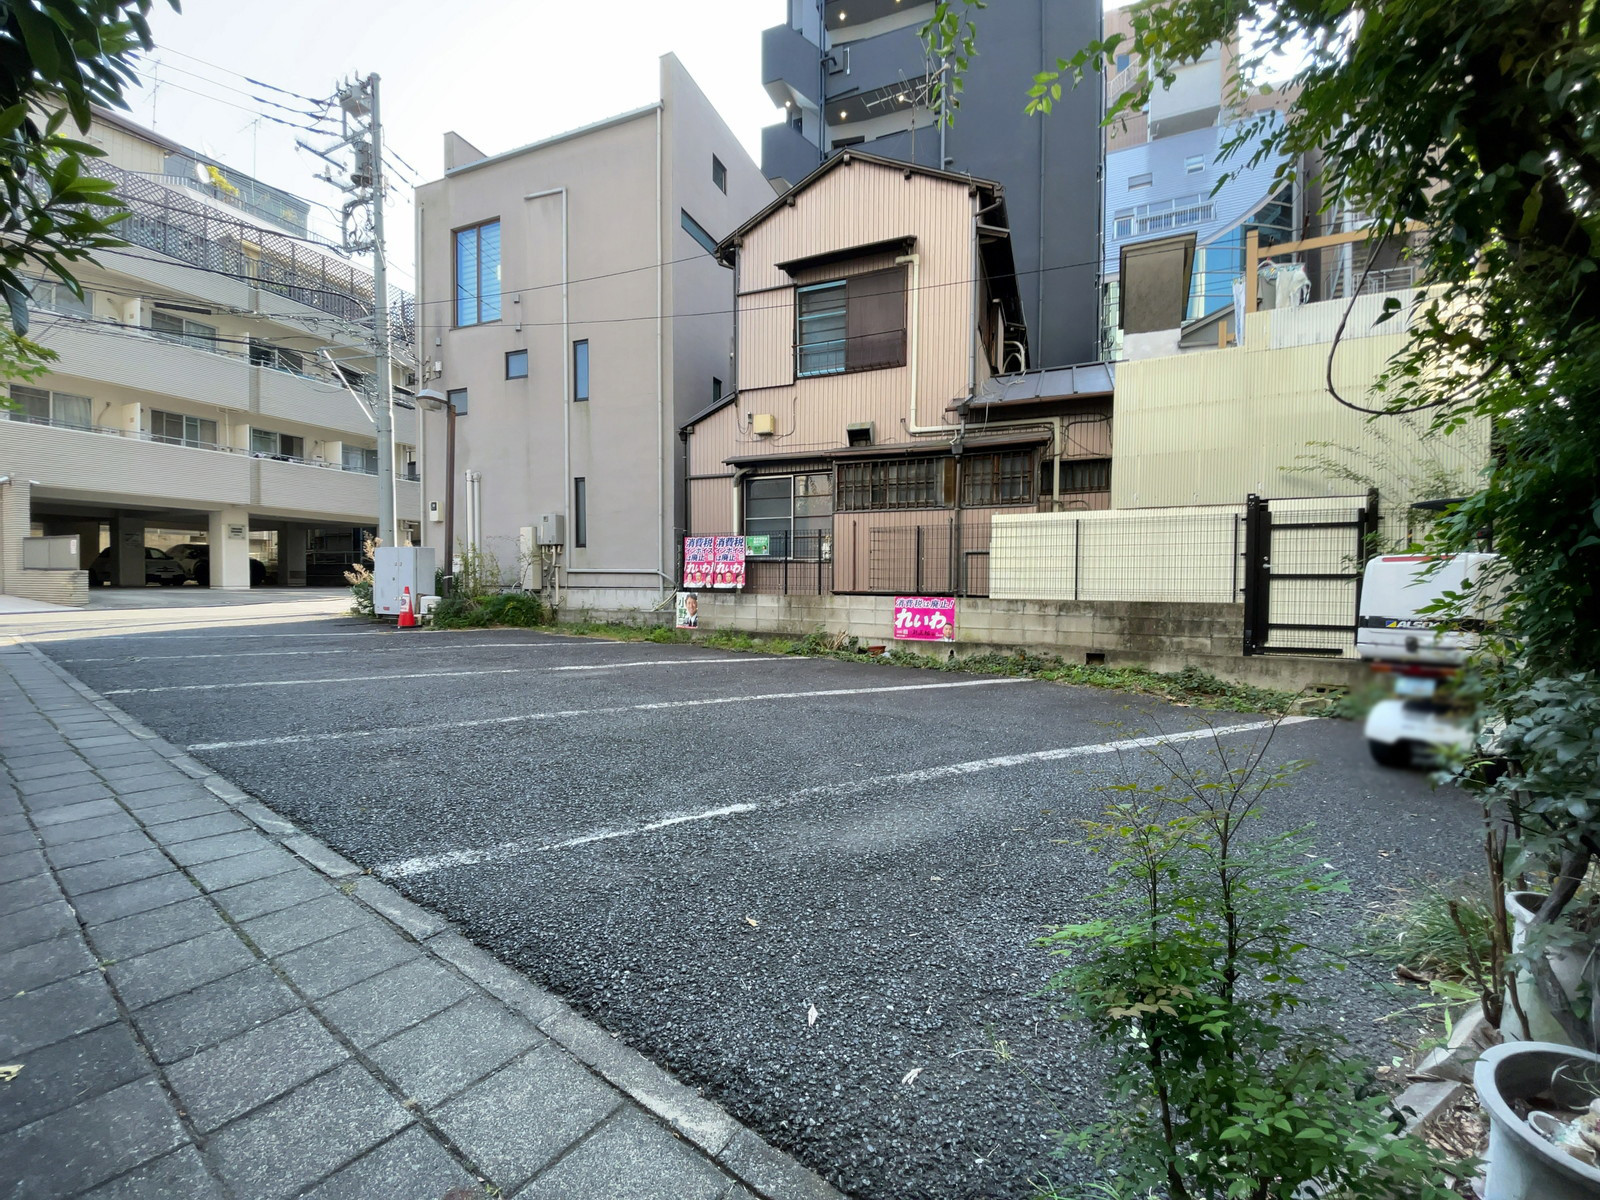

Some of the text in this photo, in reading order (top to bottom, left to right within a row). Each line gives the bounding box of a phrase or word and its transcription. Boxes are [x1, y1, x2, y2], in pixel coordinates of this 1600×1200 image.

[686, 538, 713, 548] 消費税
[716, 537, 744, 547] 消費税
[687, 563, 711, 573] れいわ
[716, 563, 742, 573] れいわ
[895, 608, 947, 629] れいわ
